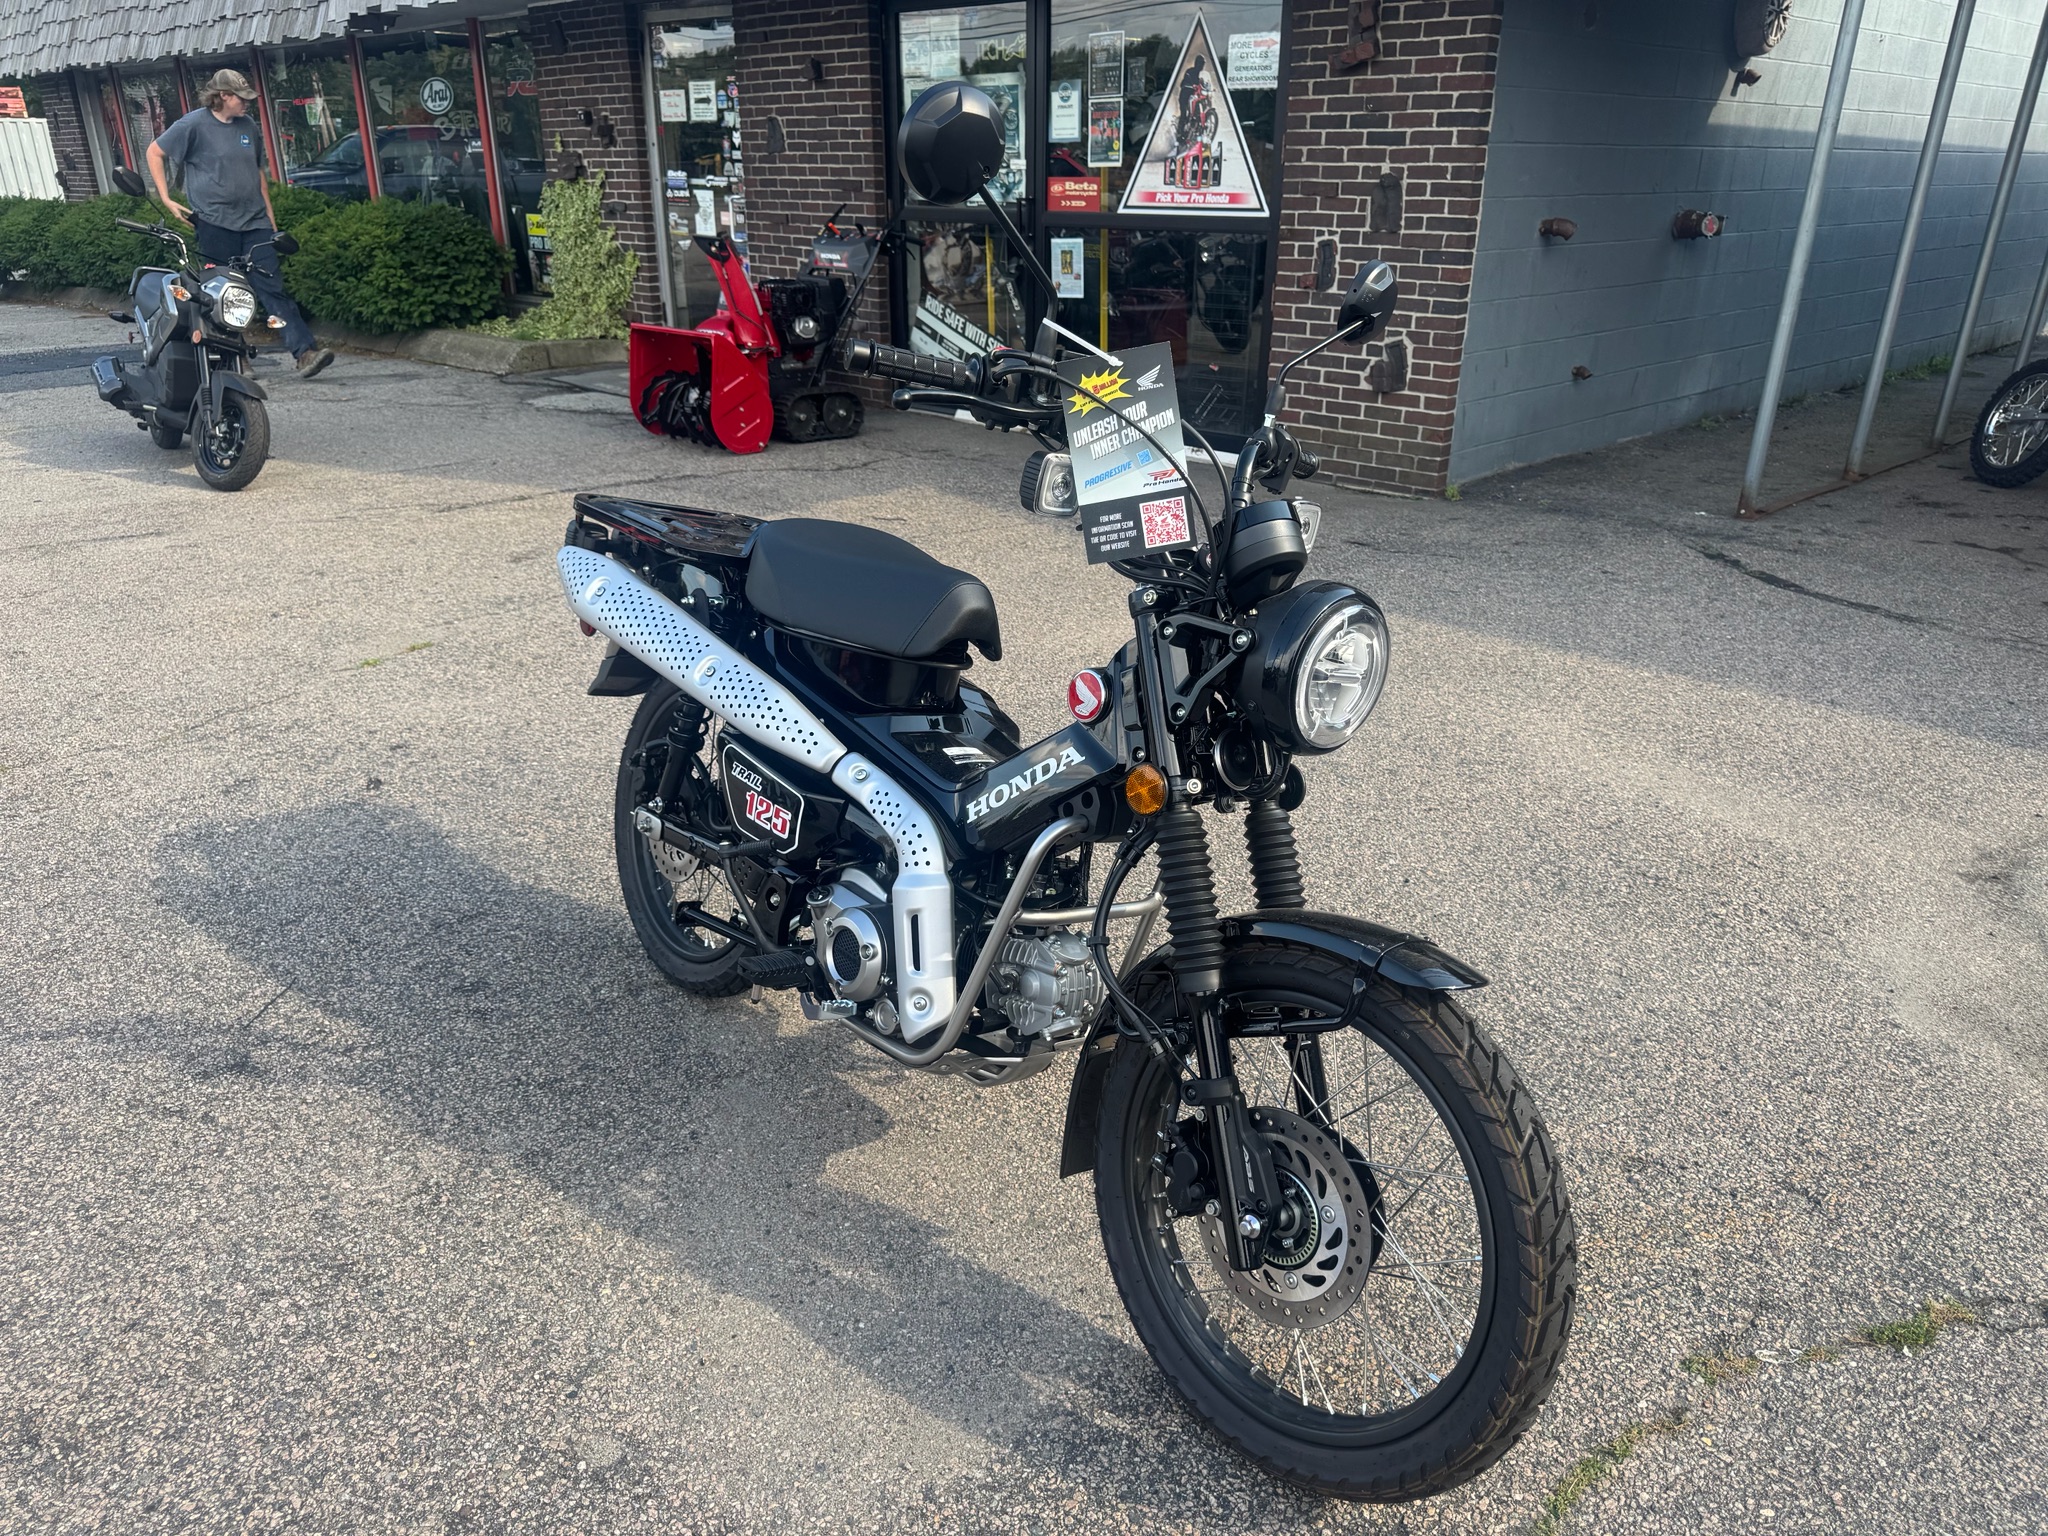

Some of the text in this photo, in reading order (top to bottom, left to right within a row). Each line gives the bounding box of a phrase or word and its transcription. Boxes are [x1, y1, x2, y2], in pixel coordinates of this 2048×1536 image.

[1230, 41, 1253, 49] MORE
[1240, 51, 1269, 59] CYCLES
[424, 83, 449, 104] Arai
[1064, 181, 1098, 191] Beta
[1155, 192, 1230, 204] Pick Your Pro Honda
[924, 294, 945, 320] RIDE
[943, 306, 966, 333] SAFE
[964, 320, 988, 349] WITH
[1137, 382, 1165, 392] HONDA
[1073, 413, 1119, 448] UNLEASH
[1090, 433, 1121, 460] INNER
[1084, 461, 1133, 489] PROGRESSIVE
[1099, 512, 1122, 523] FOR MORE
[1091, 520, 1134, 534] INFORMATION SCAN
[1090, 536, 1099, 544] THE
[1106, 532, 1119, 541] CODE
[1125, 529, 1137, 538] VISIT
[1100, 540, 1130, 552] OUR WEBSITE
[731, 761, 763, 791] TRAIL
[966, 746, 1086, 824] HONDA
[745, 790, 792, 839] 125
[1242, 1144, 1255, 1194] ABS
